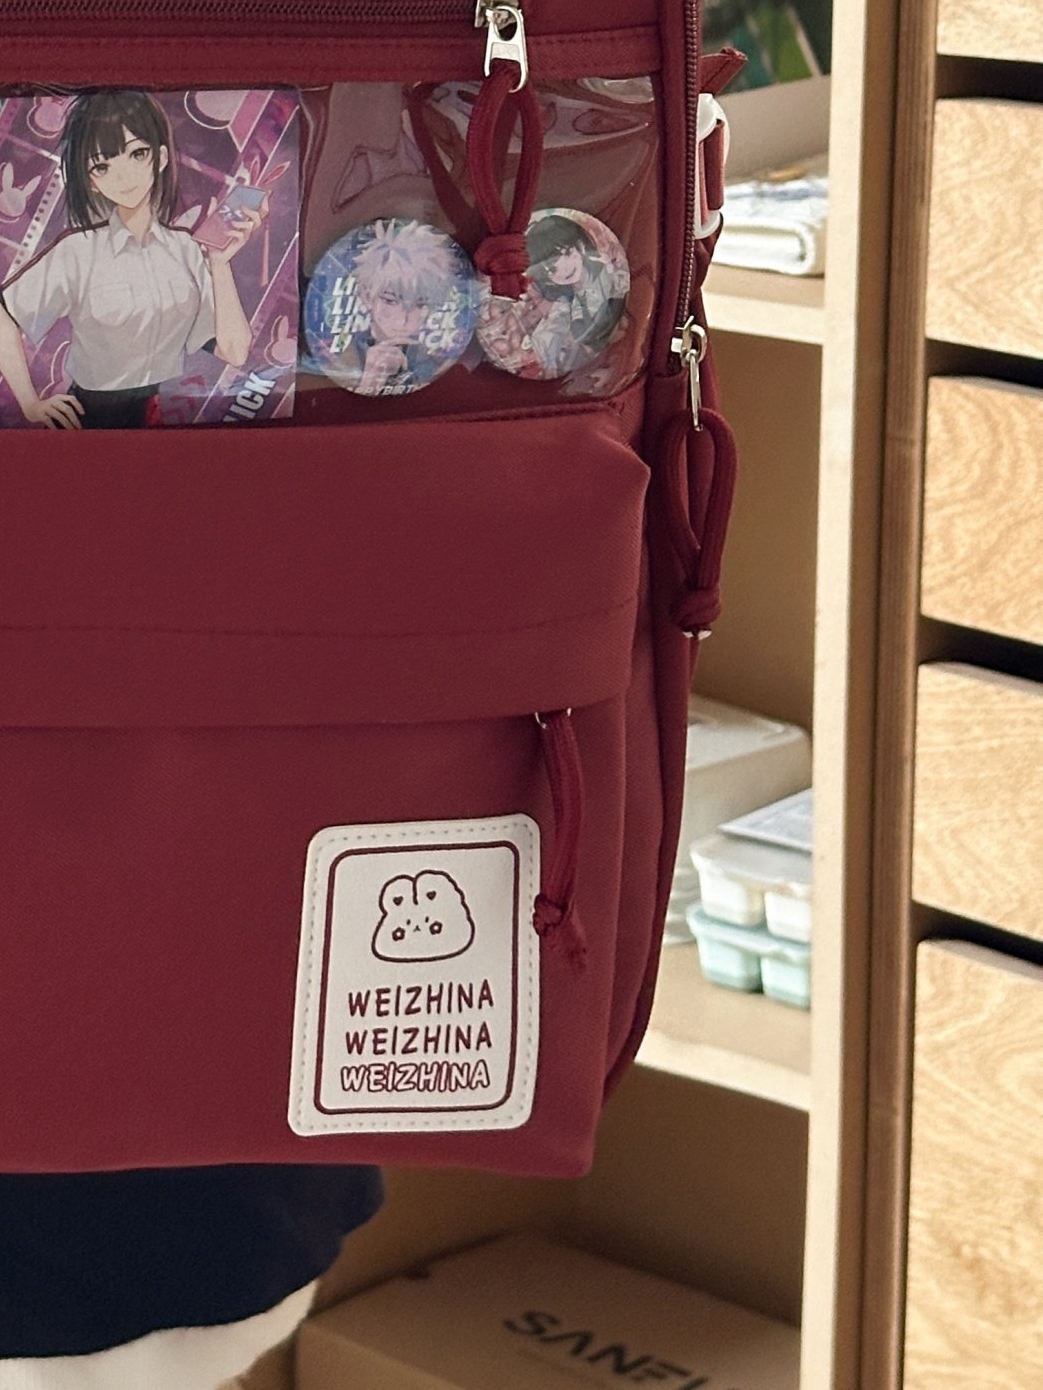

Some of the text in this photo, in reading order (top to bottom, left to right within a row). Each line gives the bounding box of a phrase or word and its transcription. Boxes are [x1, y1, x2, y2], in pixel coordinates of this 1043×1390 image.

[348, 979, 494, 1017] WEIZHINA
[345, 1022, 492, 1055] WEIZHINA
[340, 1060, 491, 1092] WEIZHINA
